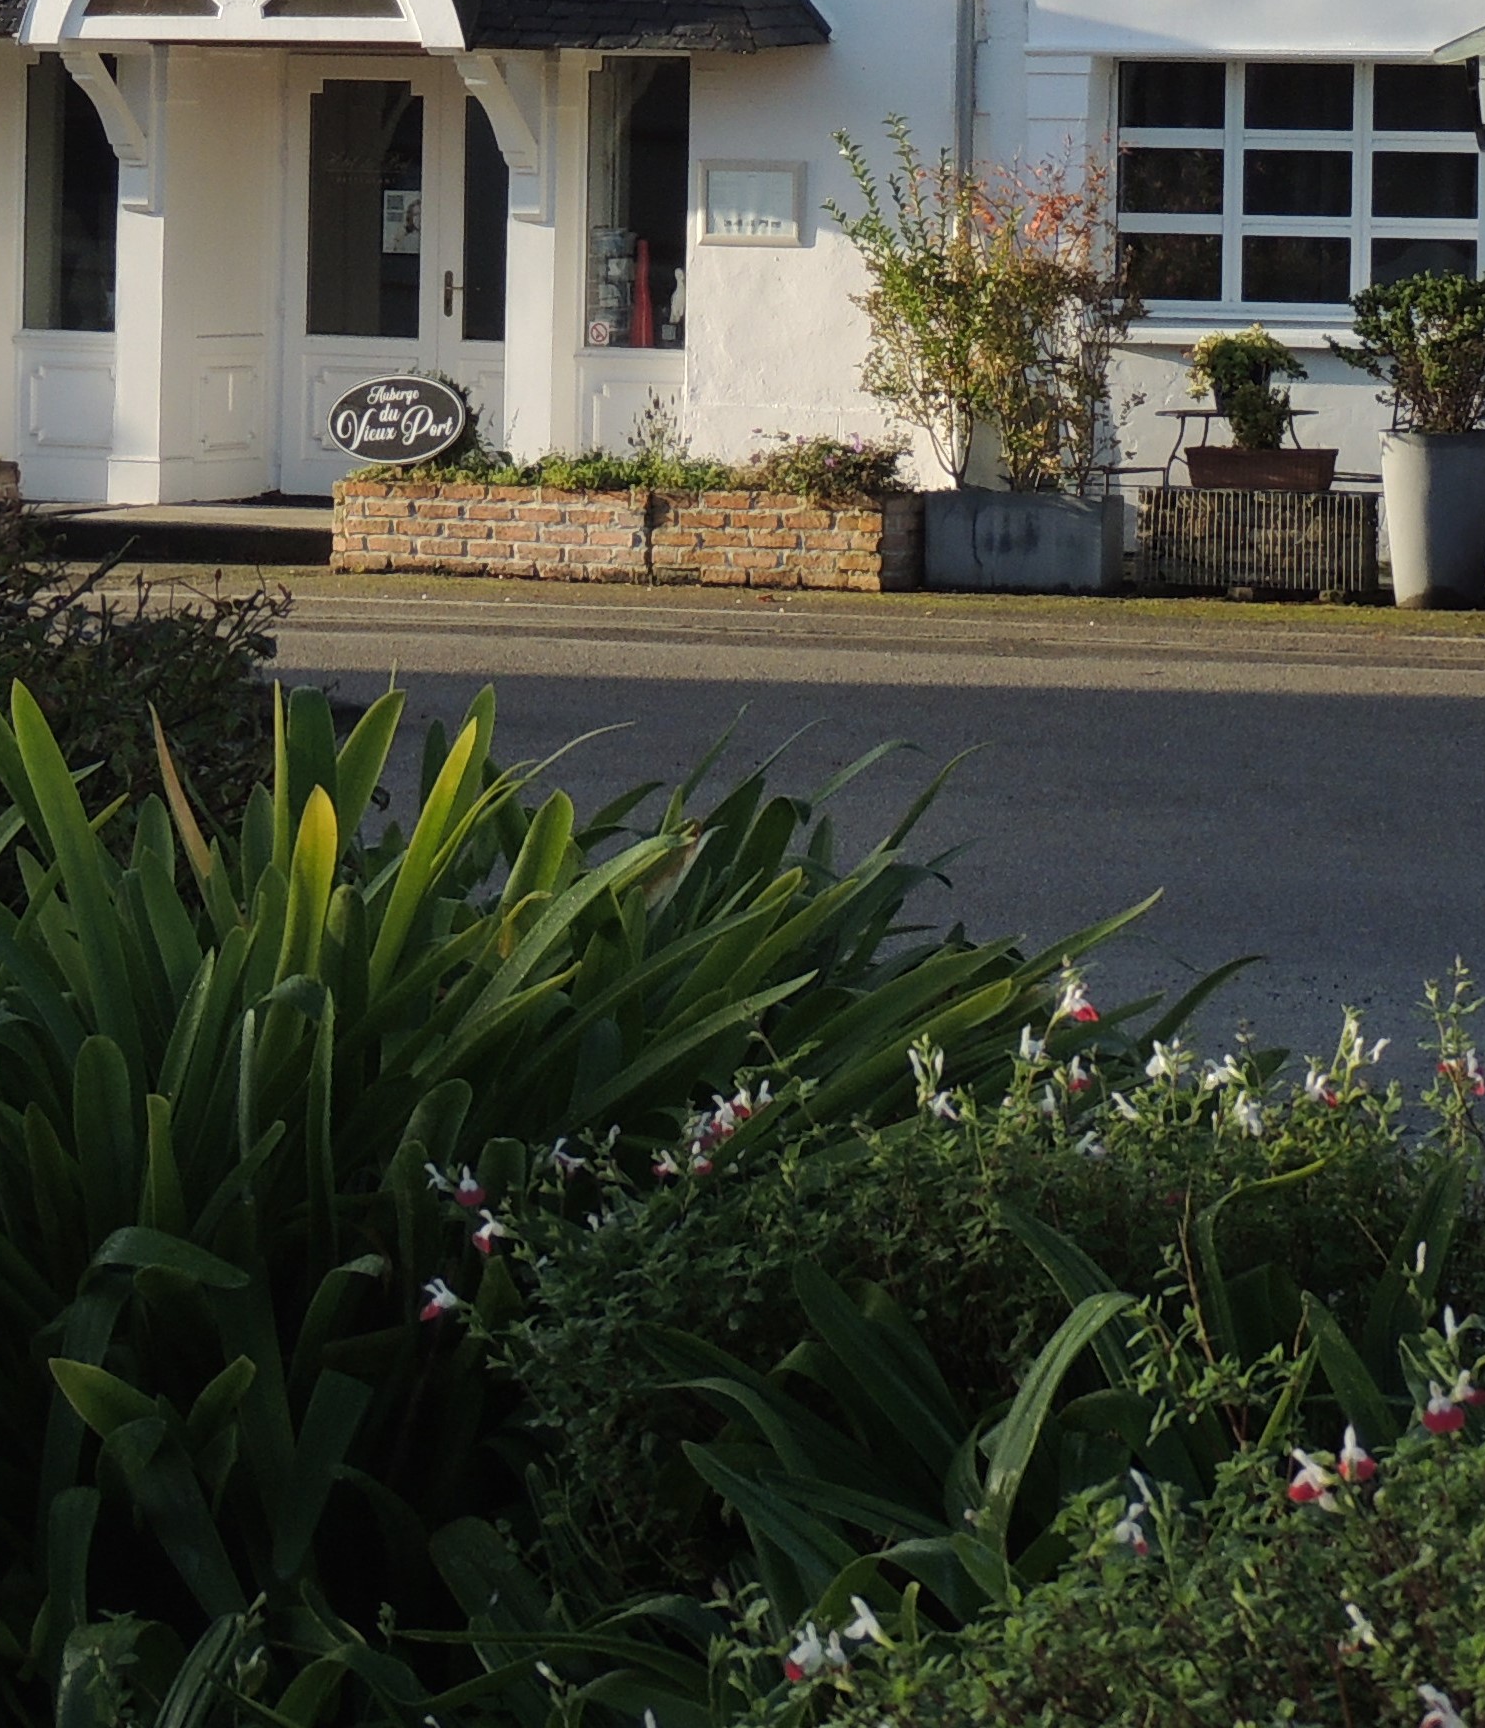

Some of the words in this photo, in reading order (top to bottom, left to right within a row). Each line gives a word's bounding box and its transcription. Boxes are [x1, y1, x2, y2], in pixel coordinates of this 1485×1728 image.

[367, 385, 419, 405] Auberge
[379, 404, 399, 422] du
[337, 408, 397, 450] Vieux
[401, 405, 452, 445] Port
